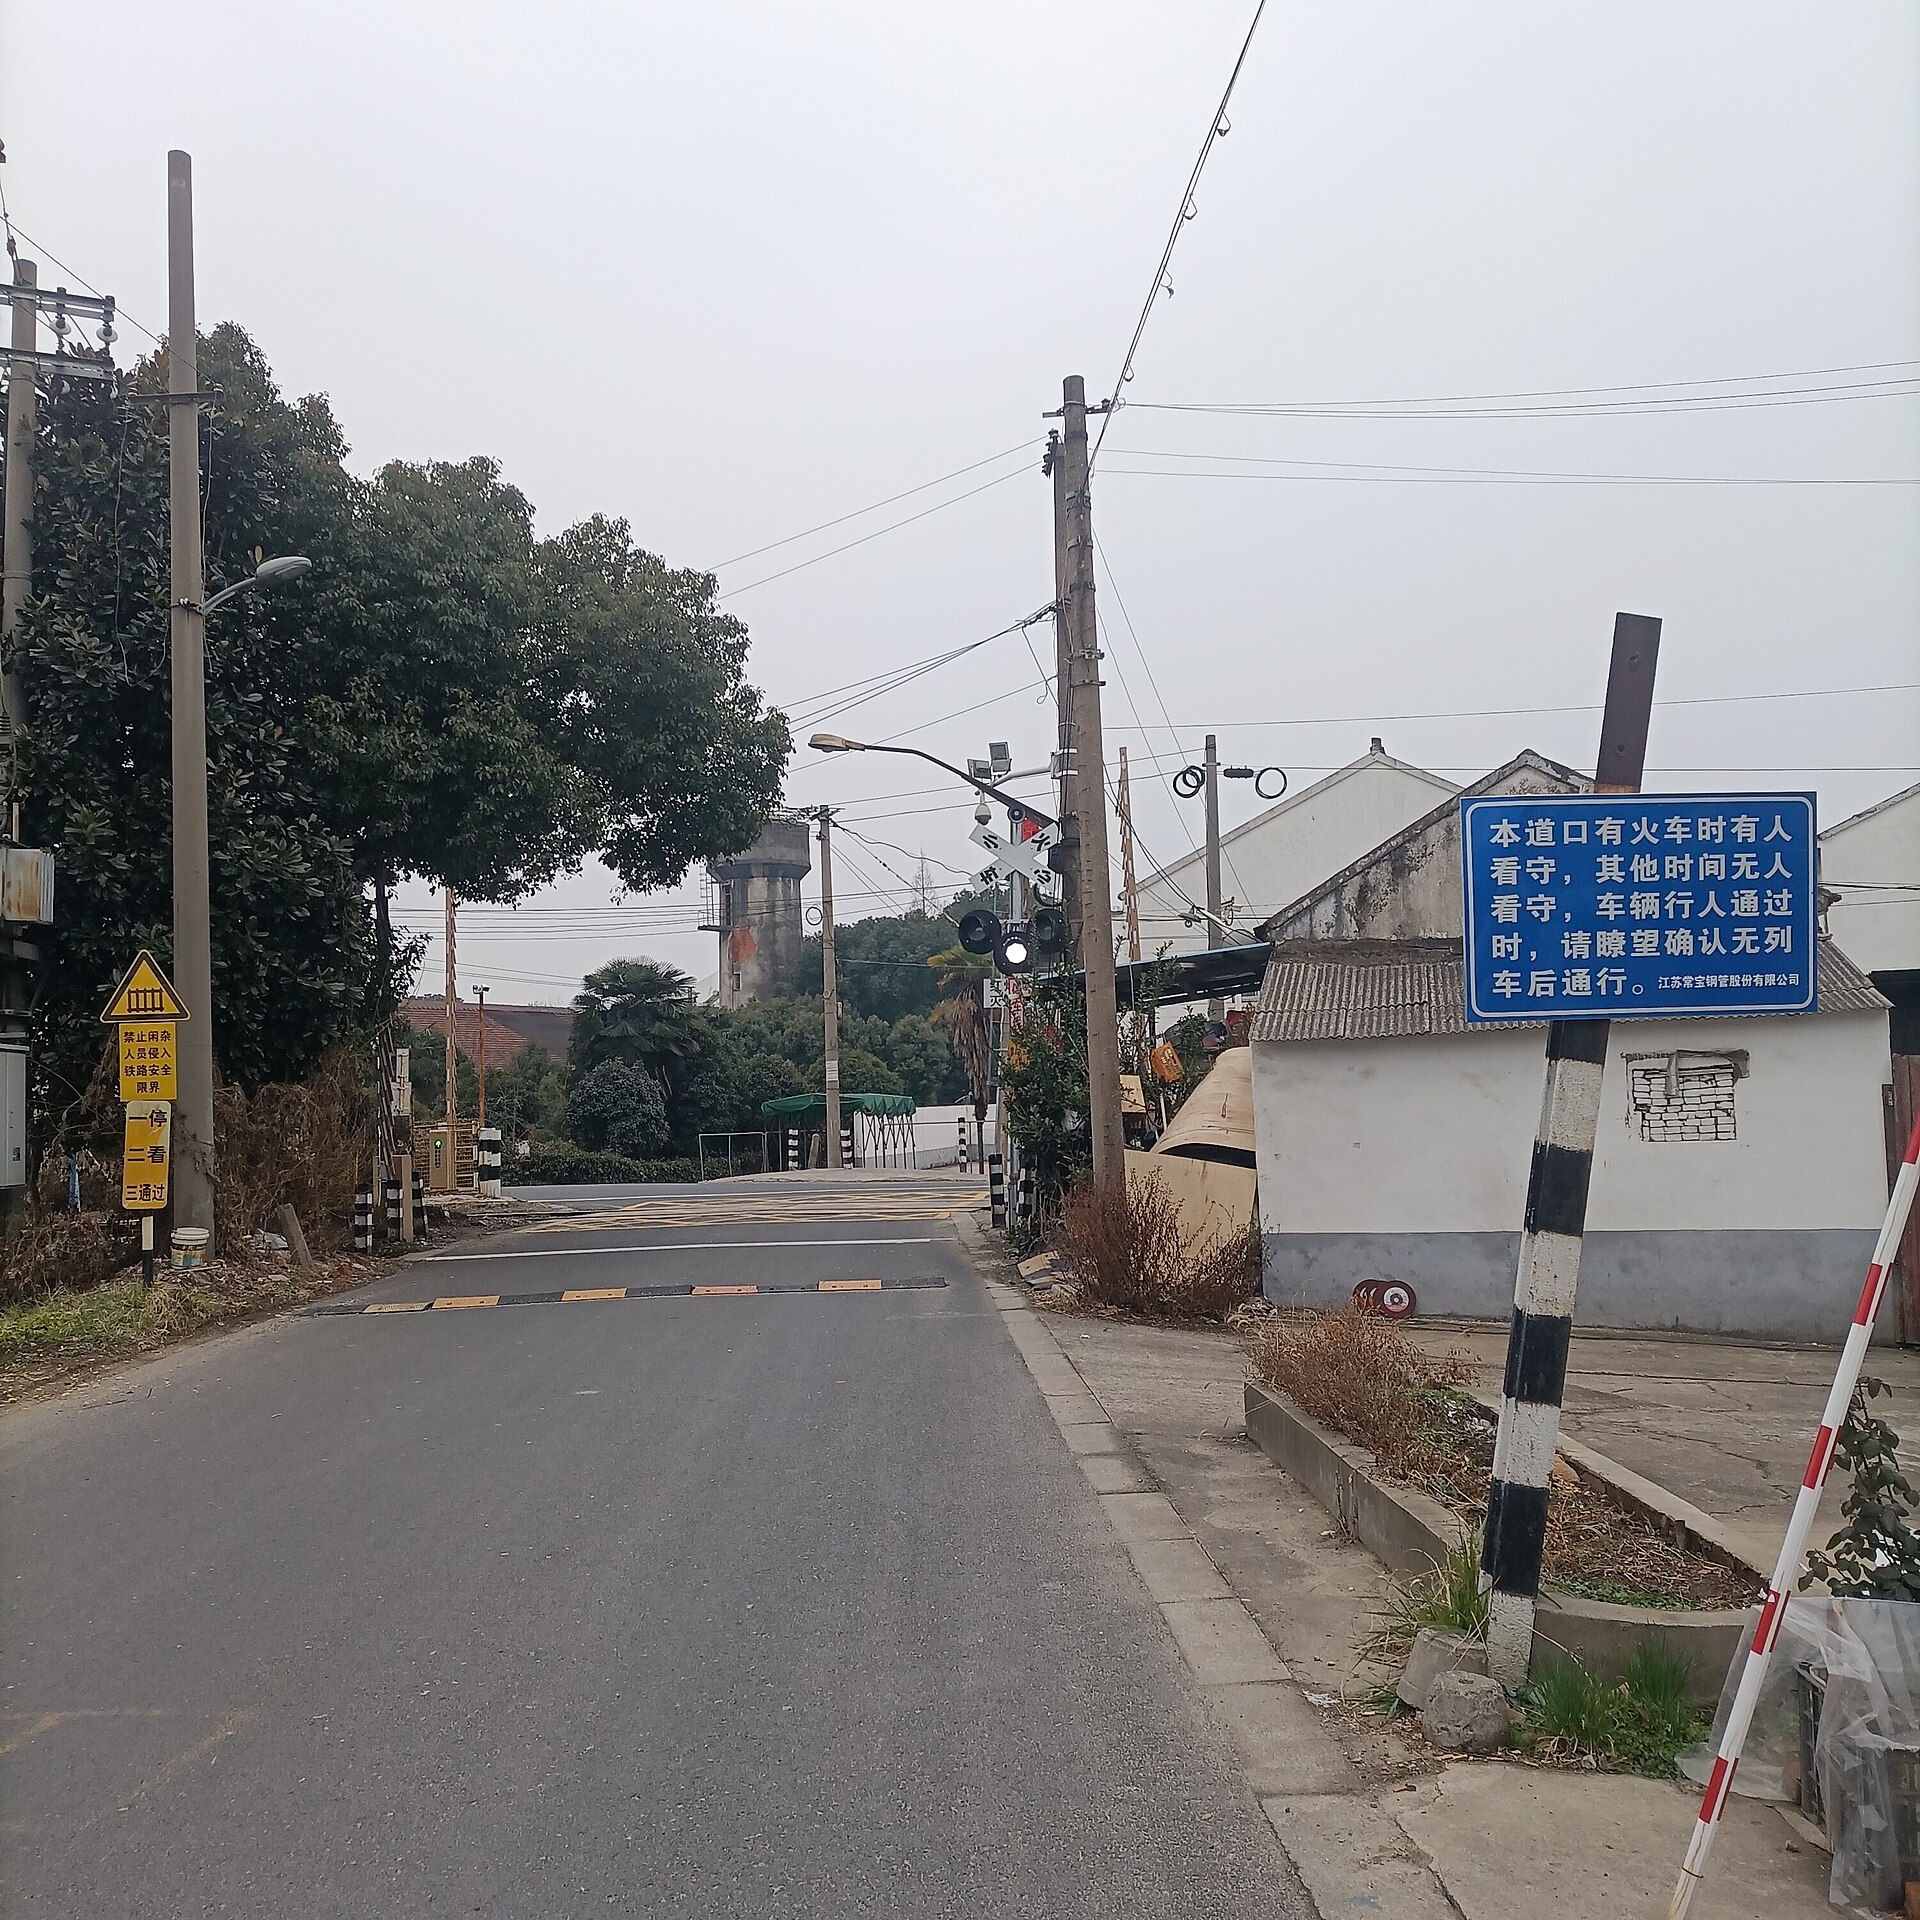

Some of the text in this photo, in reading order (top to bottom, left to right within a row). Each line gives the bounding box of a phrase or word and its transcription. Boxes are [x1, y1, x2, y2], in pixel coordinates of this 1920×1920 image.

[1490, 814, 1793, 848] 本道口有火车时有人
[1490, 852, 1793, 886] 看守，其他时间无人
[1490, 888, 1793, 924] 看守，车辆行人通过
[1492, 967, 1645, 998] 车后通行。
[1658, 973, 1800, 990] 江苏常宝钢管股份有限公司
[123, 1030, 172, 1043] 禁止闲杂
[124, 1047, 172, 1060] 人员侵入
[124, 1064, 172, 1078] 铁路安全
[136, 1081, 160, 1093] 限界
[128, 1109, 168, 1128] 一停
[127, 1145, 167, 1165] 二看
[125, 1183, 165, 1202] 三通过
